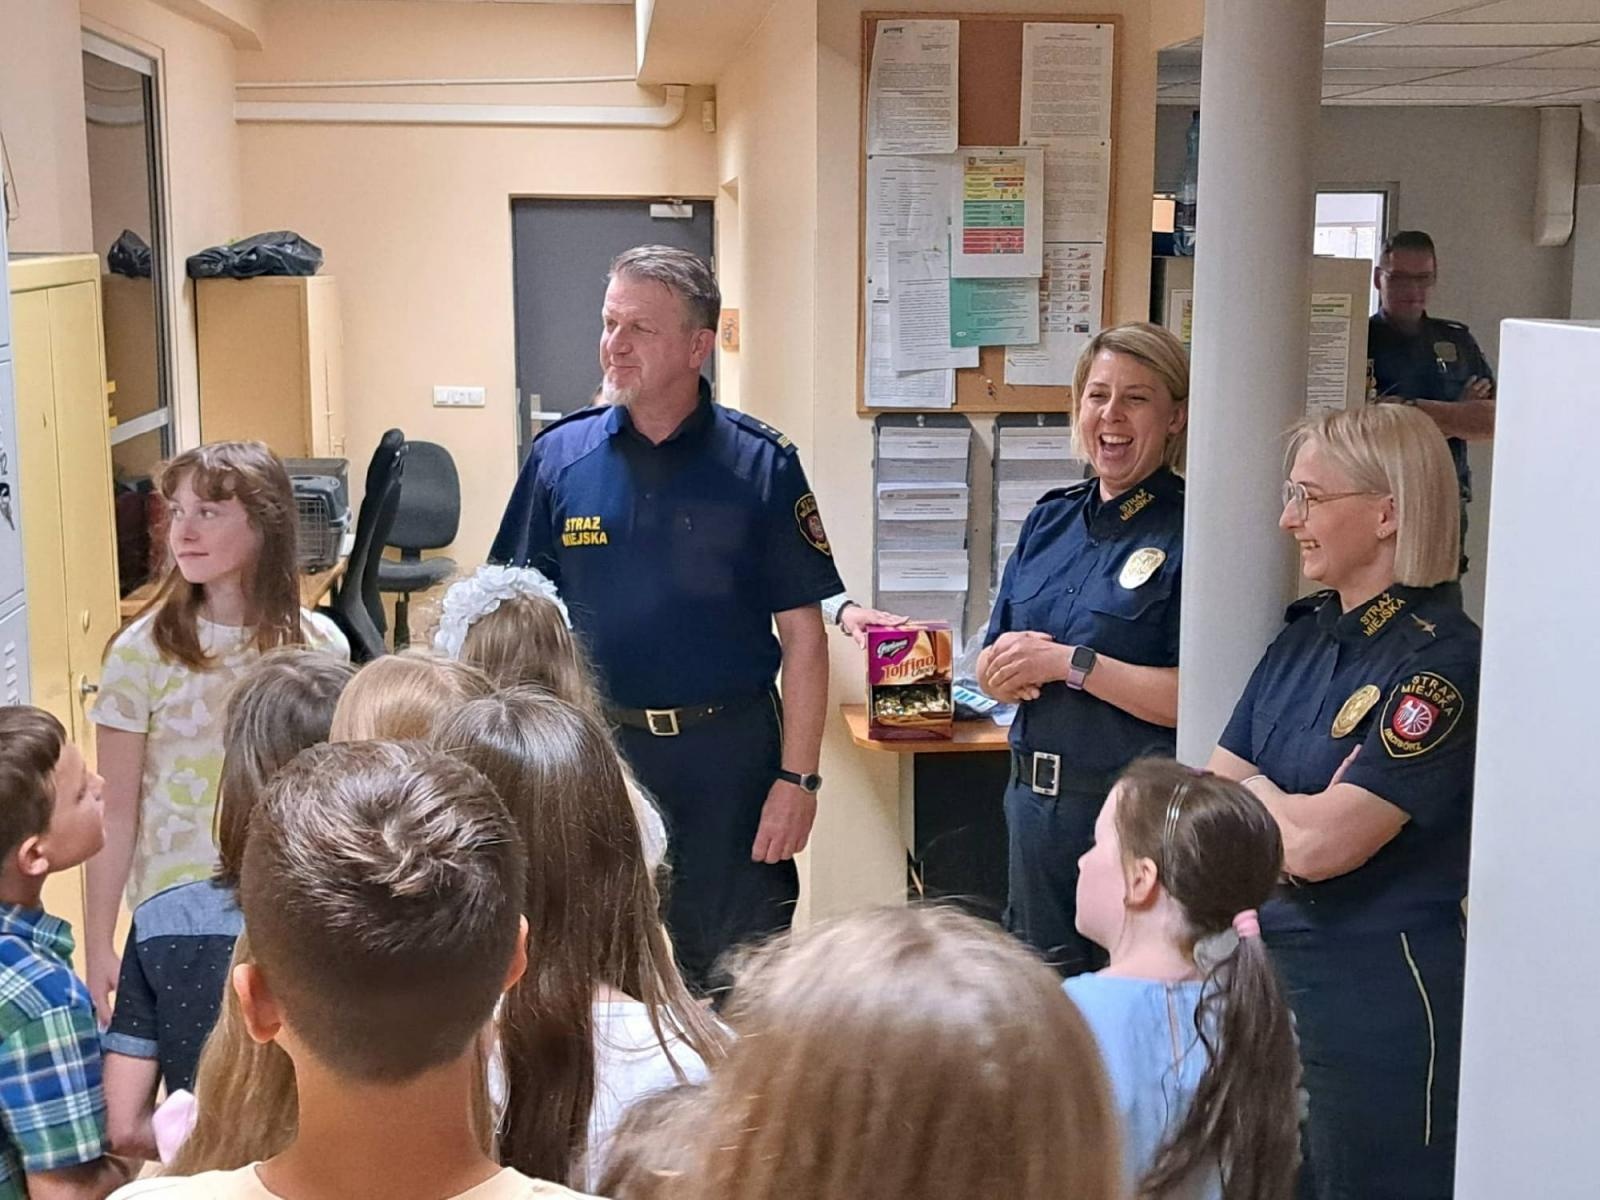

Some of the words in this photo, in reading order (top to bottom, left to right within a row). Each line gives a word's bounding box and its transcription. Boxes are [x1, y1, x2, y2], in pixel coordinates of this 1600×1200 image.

[1362, 598, 1407, 637] MIEJSKA
[881, 655, 935, 680] Toffino
[1401, 684, 1455, 717] MIEJSKA
